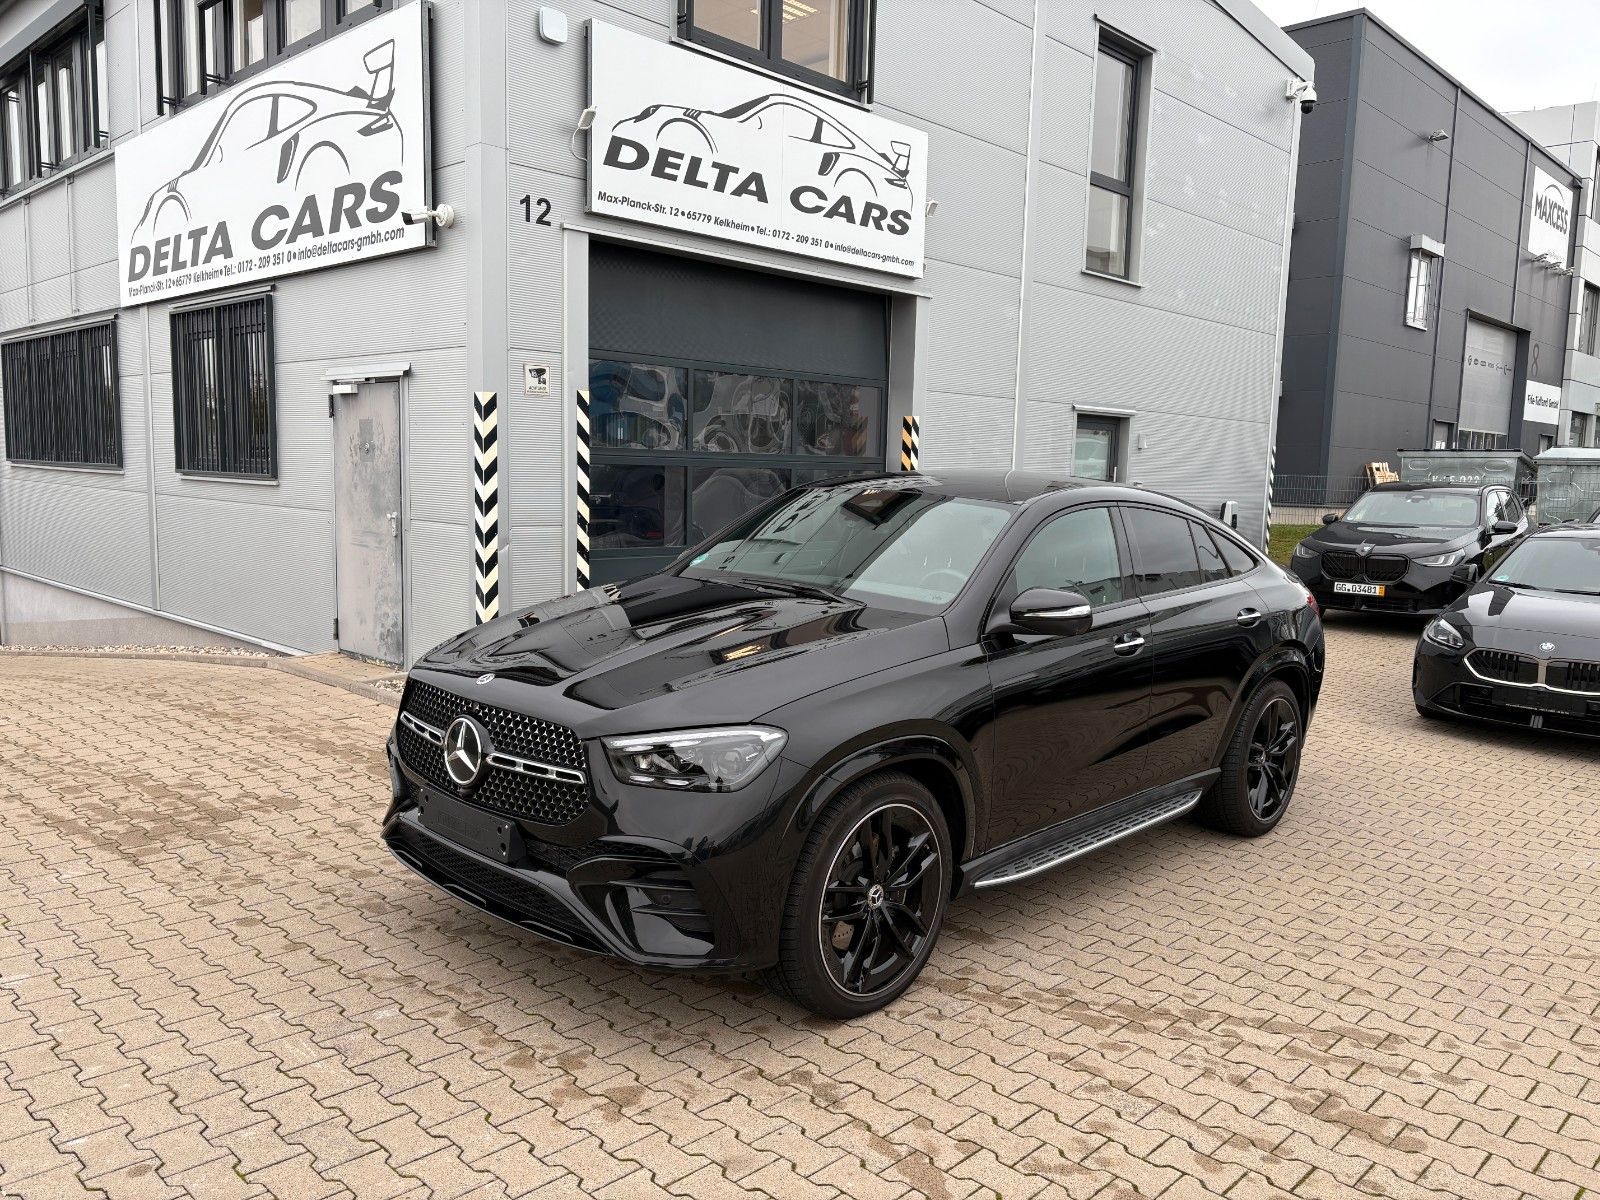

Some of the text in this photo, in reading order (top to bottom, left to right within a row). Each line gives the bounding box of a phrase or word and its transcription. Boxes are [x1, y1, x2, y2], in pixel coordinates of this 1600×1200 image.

[519, 195, 552, 226] 12
[603, 135, 912, 236] DELTA CARS
[1534, 192, 1568, 234] MAXCESS
[128, 170, 403, 282] DELTA CARS
[165, 278, 172, 289] 12
[175, 274, 192, 287] 65779
[193, 268, 220, 283] Kelkheim
[237, 261, 253, 274] 0172
[258, 255, 271, 269] 209
[272, 252, 284, 267] 351
[297, 226, 405, 261] info@deltacars-gmbh.com
[598, 191, 667, 215] Max-Planck-Str.
[669, 206, 679, 217] 12
[687, 210, 712, 224] 65779
[714, 216, 750, 232] Kelkheim
[756, 225, 771, 237] Tel.:
[772, 229, 790, 240] 0172
[796, 234, 809, 244] 209
[810, 237, 823, 248] 351
[834, 242, 915, 267] info@deltacars-gmbh.com
[1531, 343, 1540, 377] 8
